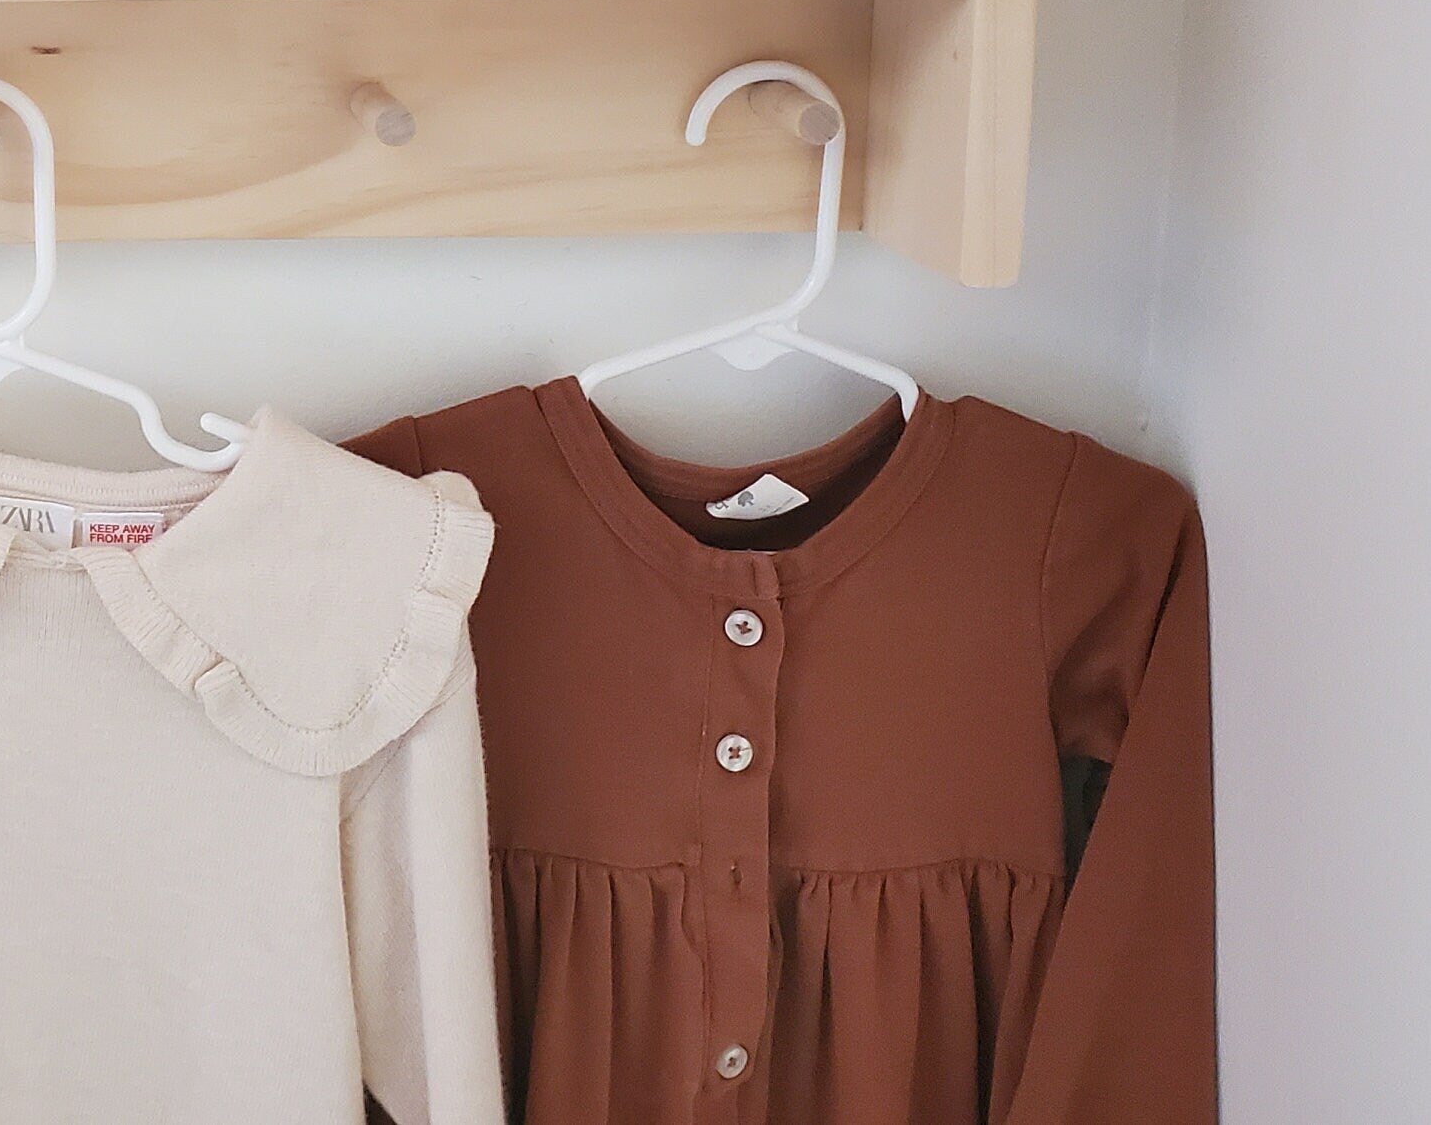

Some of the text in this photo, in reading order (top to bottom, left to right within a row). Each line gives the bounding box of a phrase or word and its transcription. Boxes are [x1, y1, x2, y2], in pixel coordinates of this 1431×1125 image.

[1, 506, 55, 533] ZARA
[89, 523, 156, 534] KEEP AWAY
[89, 533, 123, 544] FROM
